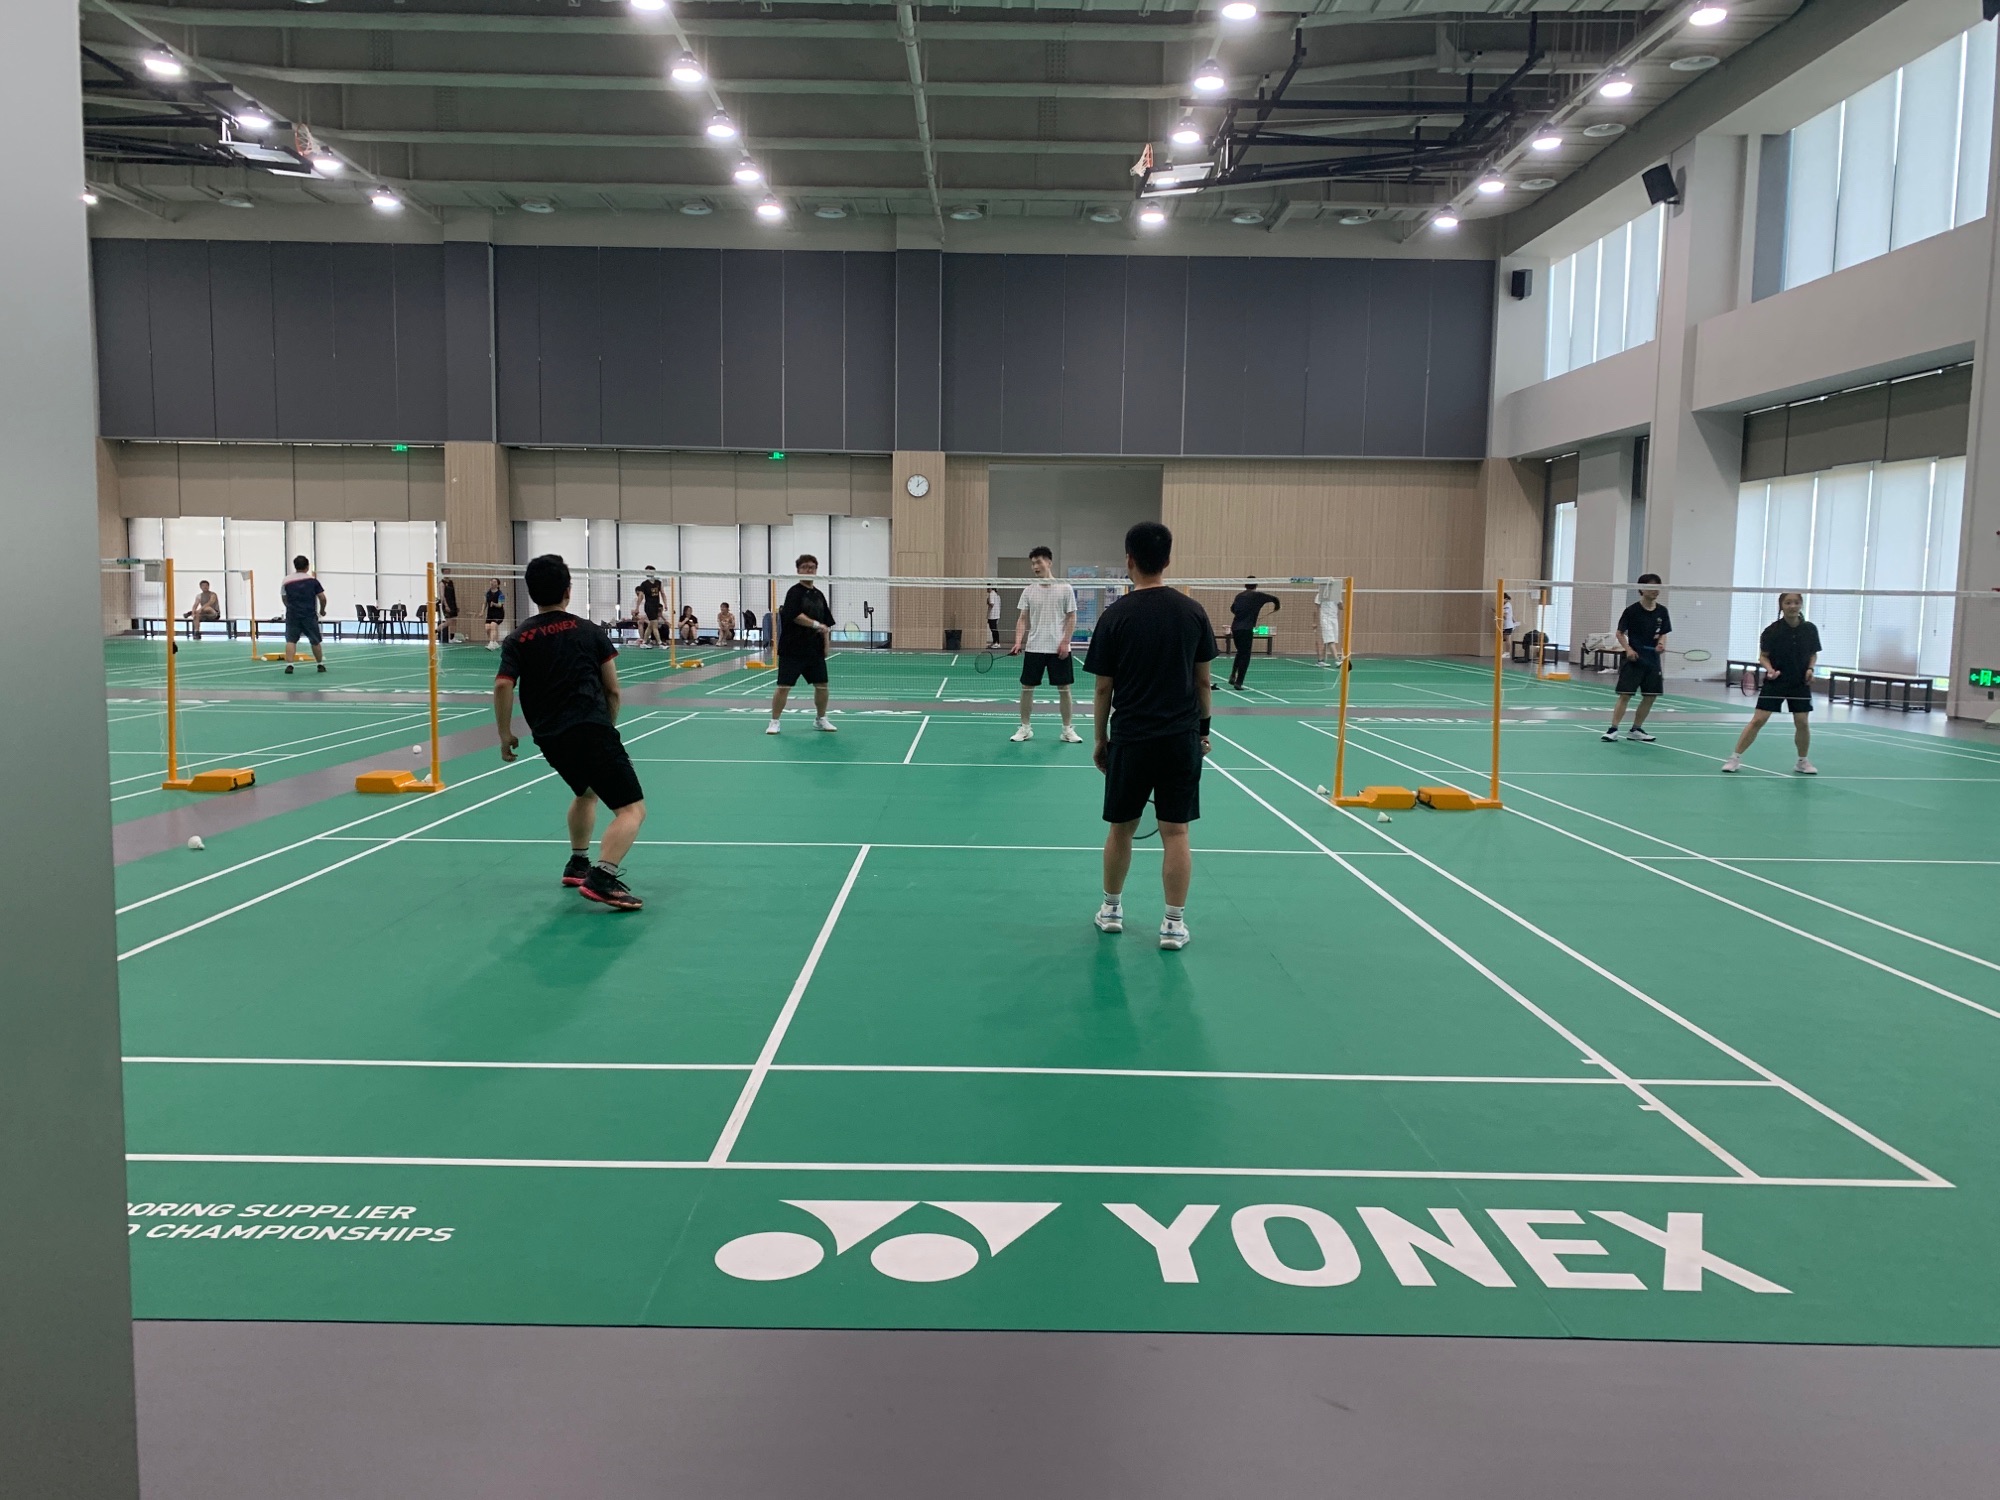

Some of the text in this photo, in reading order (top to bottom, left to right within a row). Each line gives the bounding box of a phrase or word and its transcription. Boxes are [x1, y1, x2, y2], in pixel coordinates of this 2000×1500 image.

[539, 619, 578, 637] YONEX
[125, 1202, 418, 1221] ORING SUPPLIER
[146, 1223, 457, 1243] CHAMPIONSHIPS
[1101, 1202, 1795, 1295] YONEX
